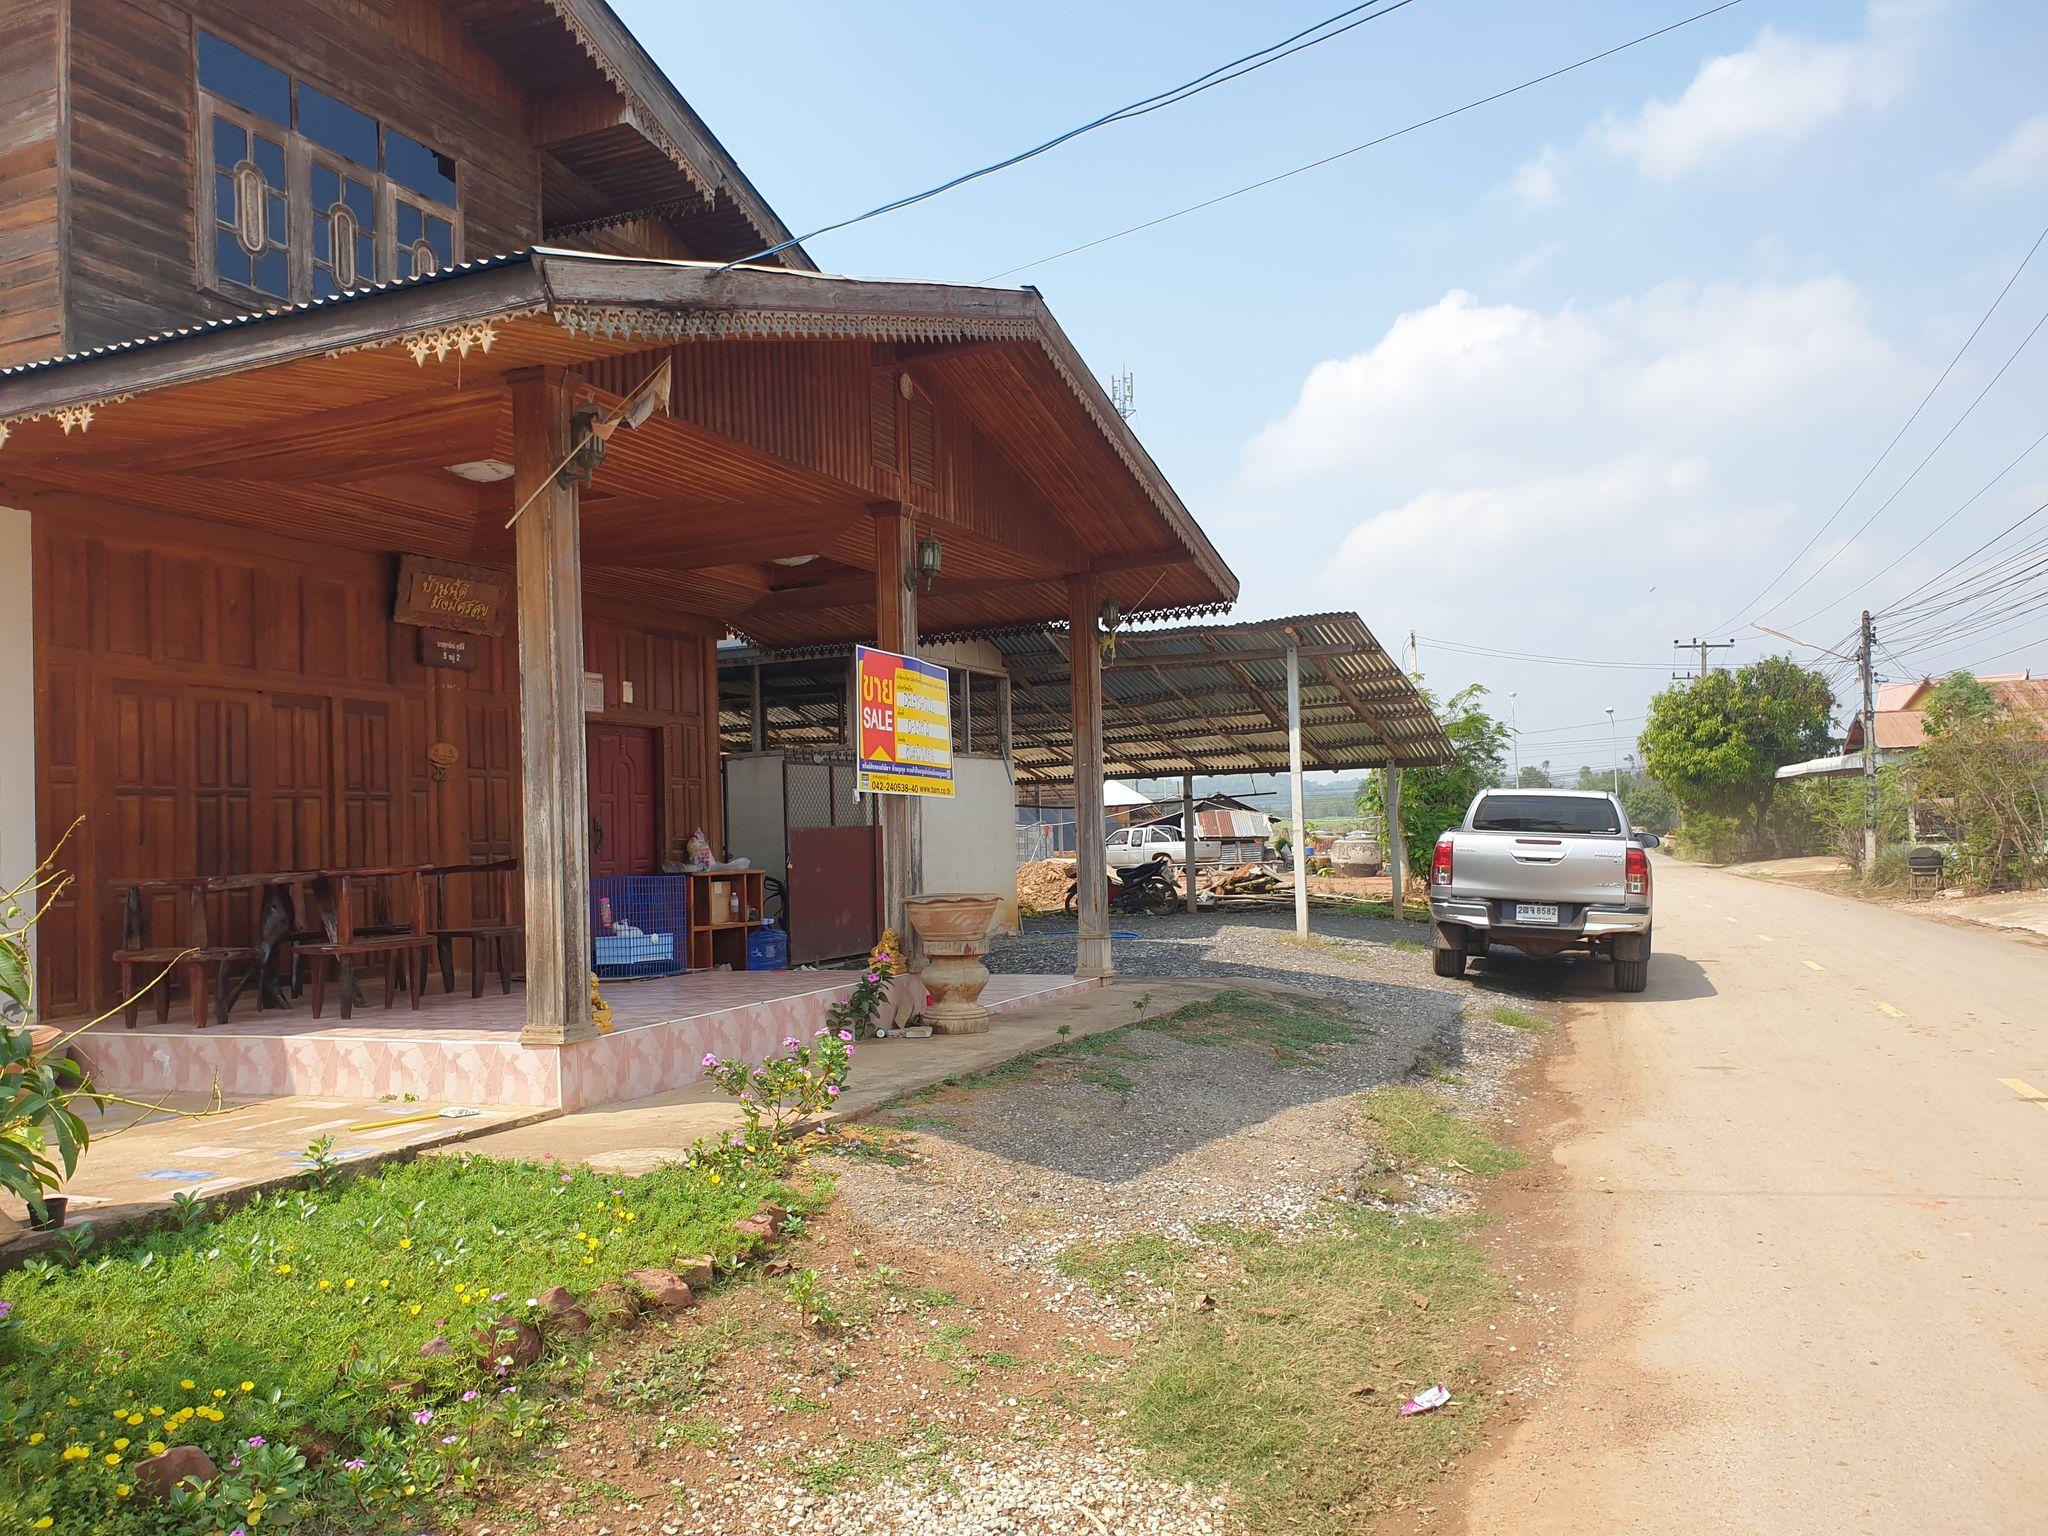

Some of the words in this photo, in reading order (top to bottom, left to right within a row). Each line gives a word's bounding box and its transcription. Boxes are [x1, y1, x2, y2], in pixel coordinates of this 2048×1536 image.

[863, 674, 893, 705] ขาย
[863, 706, 894, 732] SALE
[1536, 906, 1557, 916] 8582
